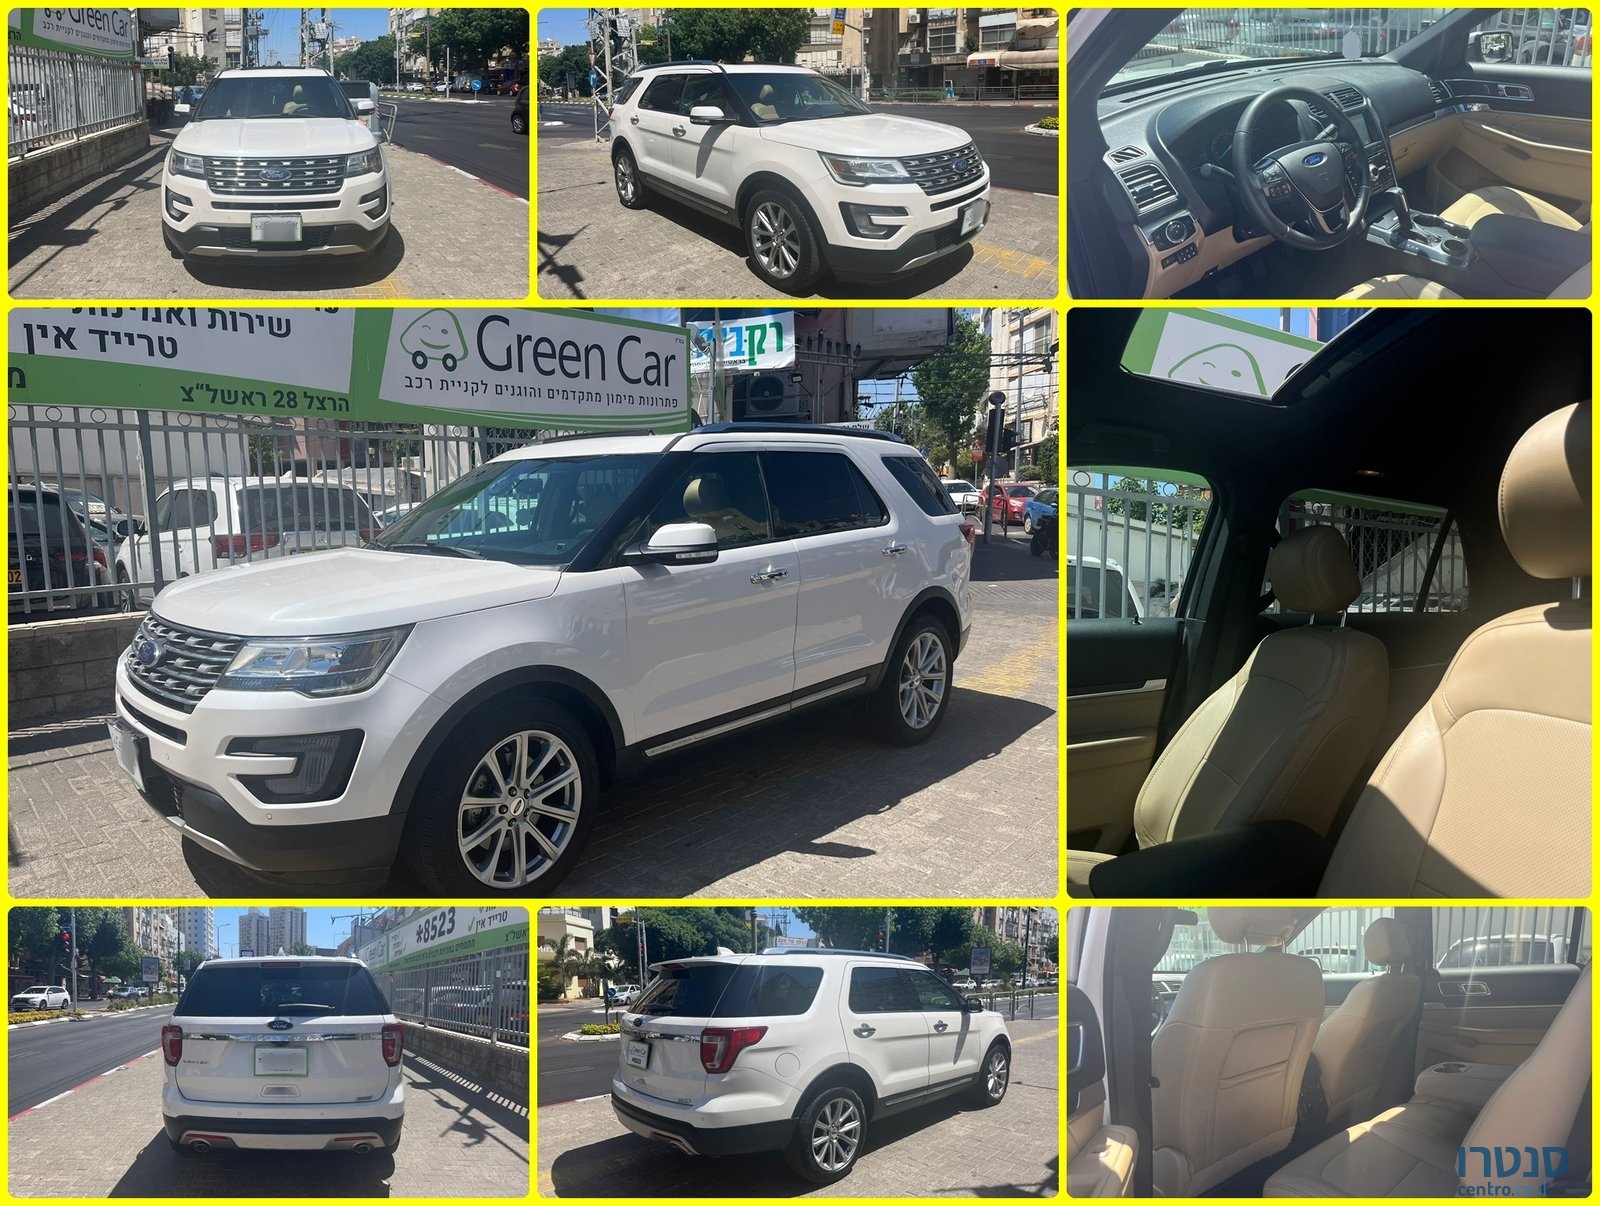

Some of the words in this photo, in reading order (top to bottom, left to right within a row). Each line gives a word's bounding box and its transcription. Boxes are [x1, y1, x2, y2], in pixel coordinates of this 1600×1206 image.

[42, 21, 54, 30] רכב
[112, 10, 128, 38] Car
[207, 307, 292, 338] שירות
[23, 323, 78, 355] אין
[88, 329, 178, 359] טרייד
[476, 314, 606, 381] Green
[617, 335, 676, 387] Car
[404, 375, 433, 390] רכב
[439, 378, 489, 397] לקניית
[495, 384, 542, 398] והוגנים
[179, 382, 267, 408] ראשל"צ
[272, 389, 298, 409] 28
[303, 391, 350, 413] הרצל
[547, 388, 602, 405] מתקדמים
[606, 392, 635, 407] מימון
[638, 396, 678, 409] פתרונות
[476, 918, 486, 934] אין
[488, 910, 508, 927] טרייד
[504, 927, 529, 942] אשל"צ
